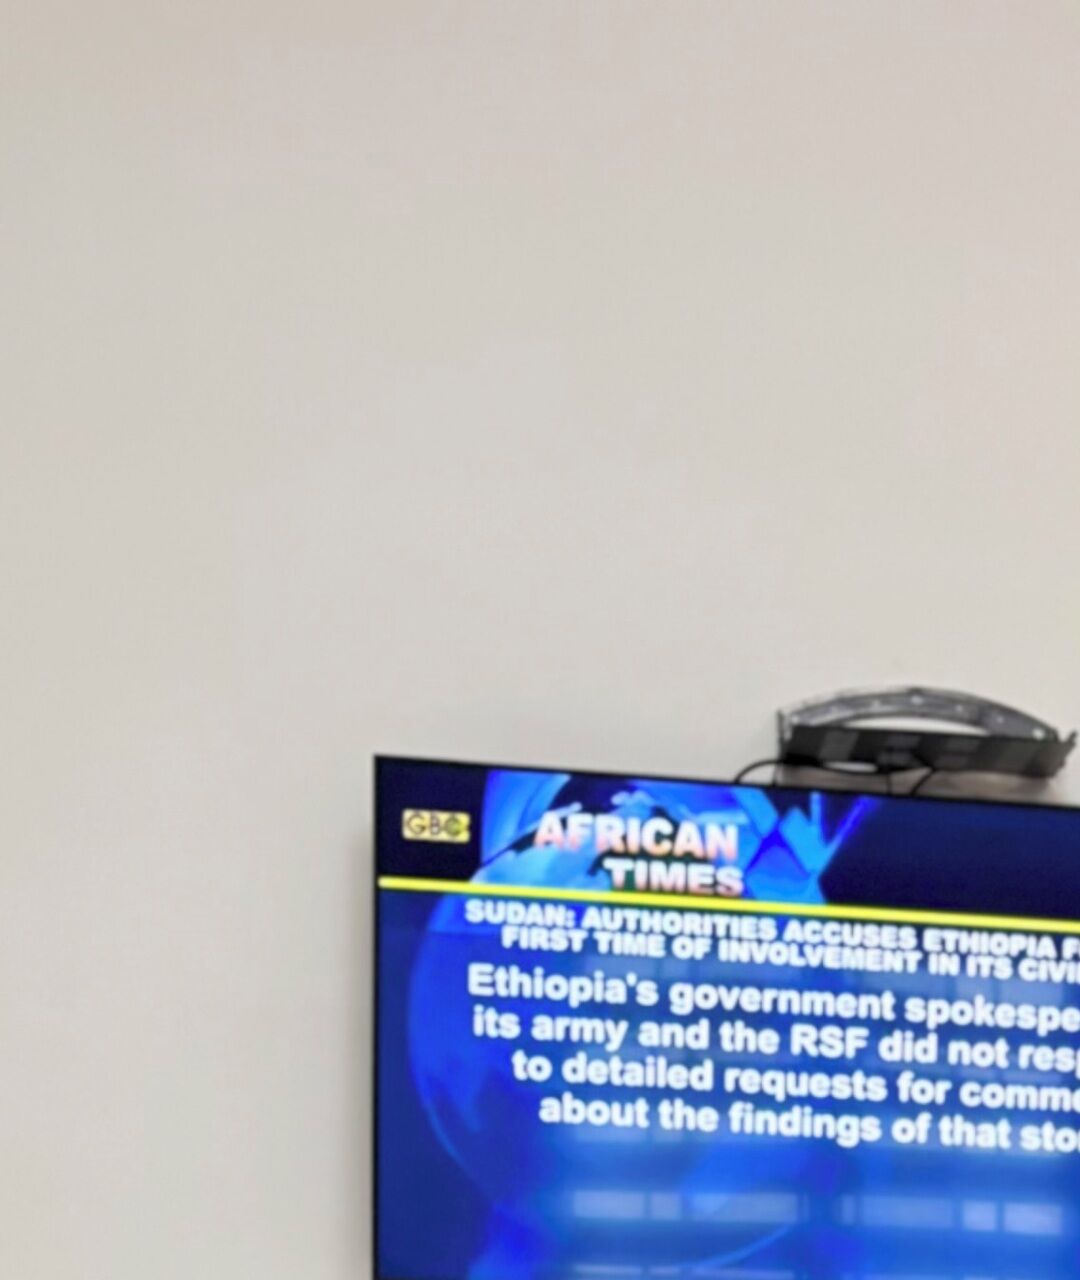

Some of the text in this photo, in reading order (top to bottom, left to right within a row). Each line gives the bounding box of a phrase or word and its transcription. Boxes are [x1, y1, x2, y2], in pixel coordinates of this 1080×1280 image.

[405, 812, 464, 837] GBC
[533, 811, 738, 861] AFRICAN
[603, 858, 744, 897] TIMES
[465, 899, 576, 928] SUDAN:
[582, 906, 778, 942] AUTHORITIES
[784, 920, 917, 950] ACCUSES
[923, 928, 1056, 959] ETHIOPIA
[502, 925, 587, 952] FIRST
[594, 931, 665, 958] TIME
[671, 935, 712, 960] OF
[717, 939, 922, 974] INVOLVEMENT
[928, 953, 960, 976] IN
[966, 955, 1013, 980] ITS
[467, 963, 658, 1008] Ethiopia's
[669, 981, 896, 1020] government
[473, 1004, 521, 1039] its
[530, 1014, 628, 1052] army
[638, 1018, 710, 1050] and
[719, 1020, 780, 1054] the
[790, 1022, 869, 1059] RSF
[878, 1030, 938, 1064] did
[947, 1037, 1009, 1069] not
[511, 1050, 552, 1081] to
[561, 1051, 714, 1091] detailed
[724, 1067, 887, 1102] requests
[898, 1070, 951, 1105] for
[539, 1091, 649, 1129] about
[658, 1097, 718, 1132] the
[728, 1101, 882, 1148] findings
[891, 1111, 932, 1144] of
[939, 1114, 1011, 1150] that
